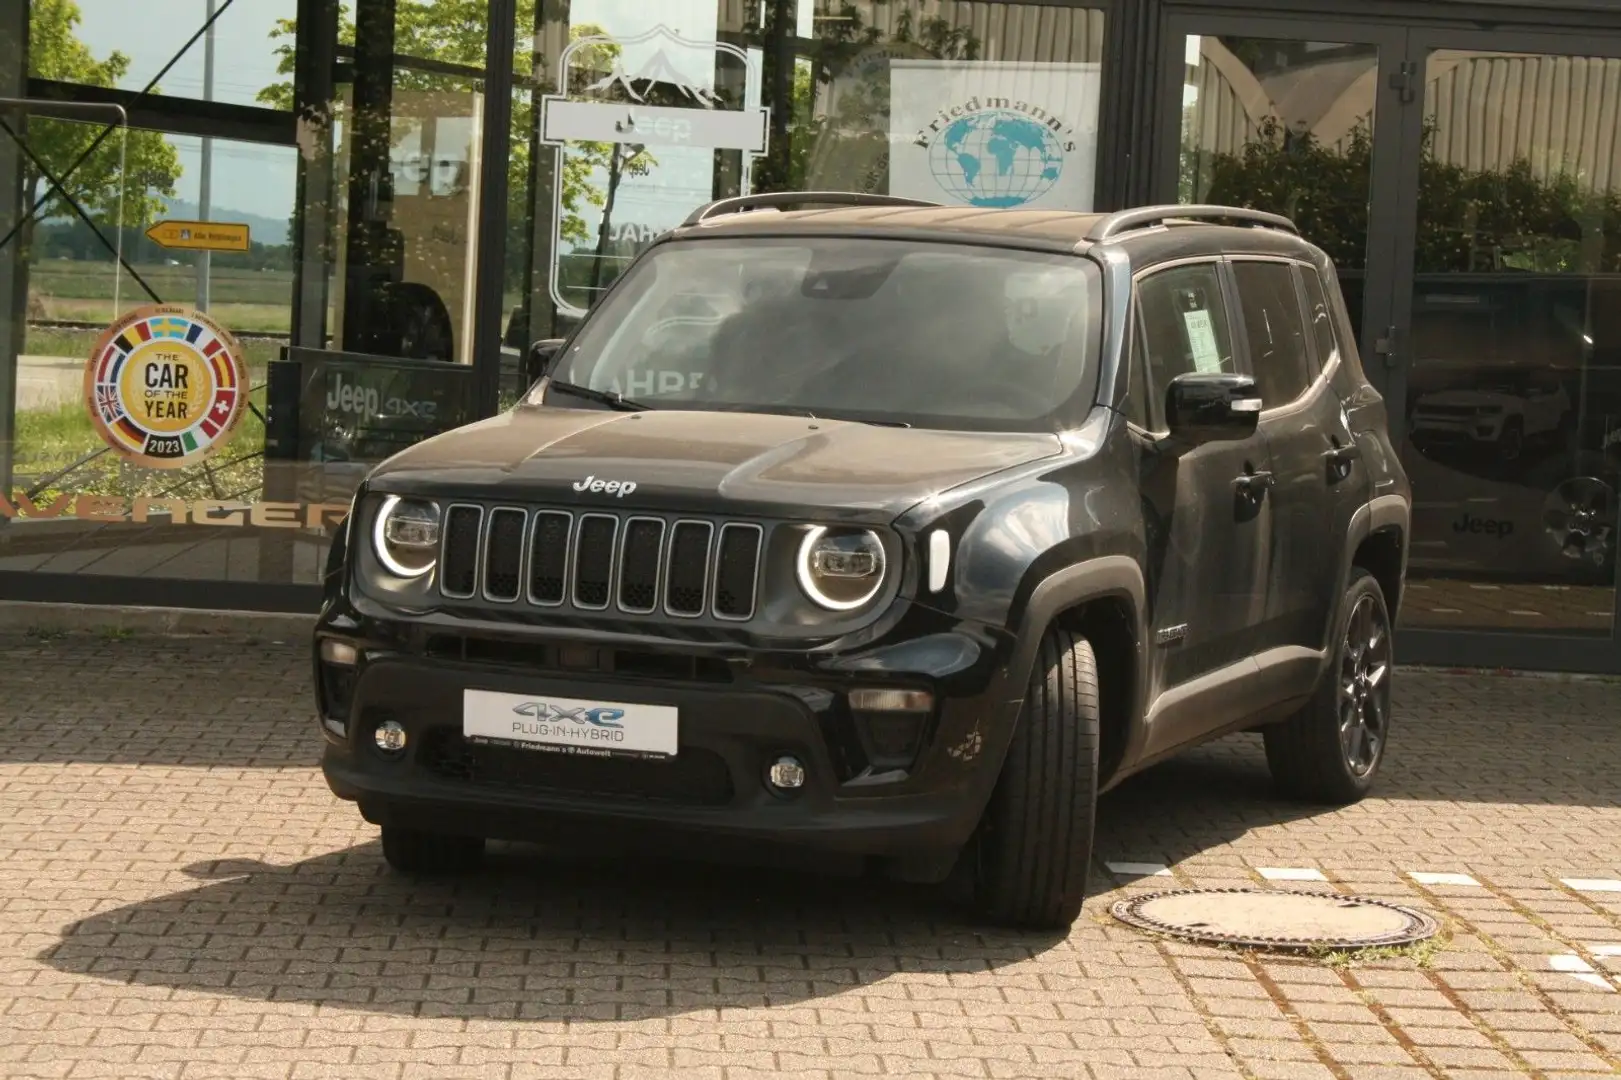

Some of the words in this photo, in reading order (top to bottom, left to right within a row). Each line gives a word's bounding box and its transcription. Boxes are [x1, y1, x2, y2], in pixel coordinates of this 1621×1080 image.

[145, 362, 188, 389] CAR
[144, 390, 160, 398] OF
[164, 390, 187, 399] THE
[327, 373, 378, 423] Jeep
[144, 400, 188, 419] YEAR
[149, 440, 180, 454] 2023
[573, 475, 637, 498] Jeep
[1453, 512, 1513, 539] Jeep
[512, 722, 624, 742] PLUG-IN-HYBRID
